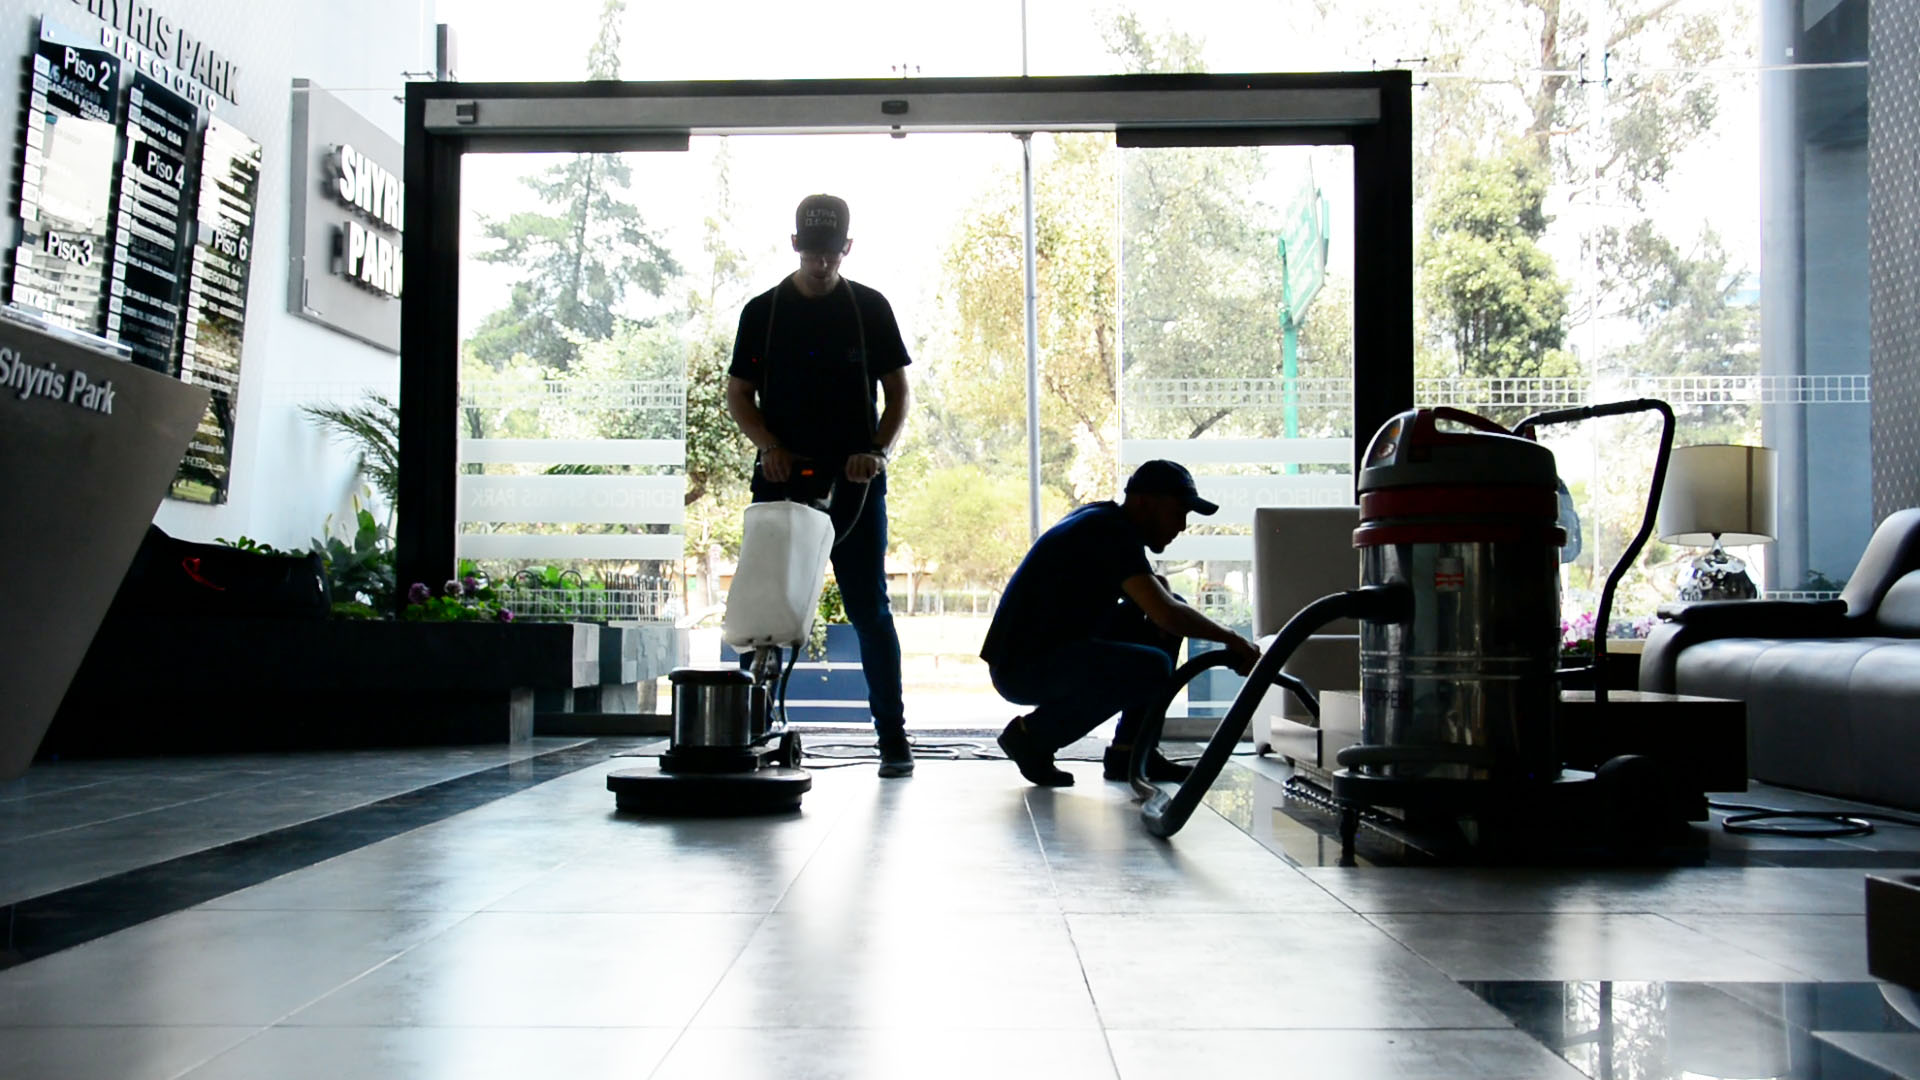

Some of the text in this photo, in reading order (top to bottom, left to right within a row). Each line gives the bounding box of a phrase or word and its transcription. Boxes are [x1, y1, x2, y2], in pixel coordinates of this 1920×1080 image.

[64, 46, 96, 82] Piso
[98, 61, 112, 91] 2
[70, 0, 173, 59] YRIS
[176, 29, 239, 105] PARK
[101, 27, 217, 112] DIRECTORIO
[147, 150, 174, 182] Piso
[175, 163, 185, 190] 4
[339, 143, 404, 232] SHYRI
[47, 231, 94, 267] Piso 3
[214, 229, 249, 260] Piso 6
[0, 347, 116, 414] Shyris Park
